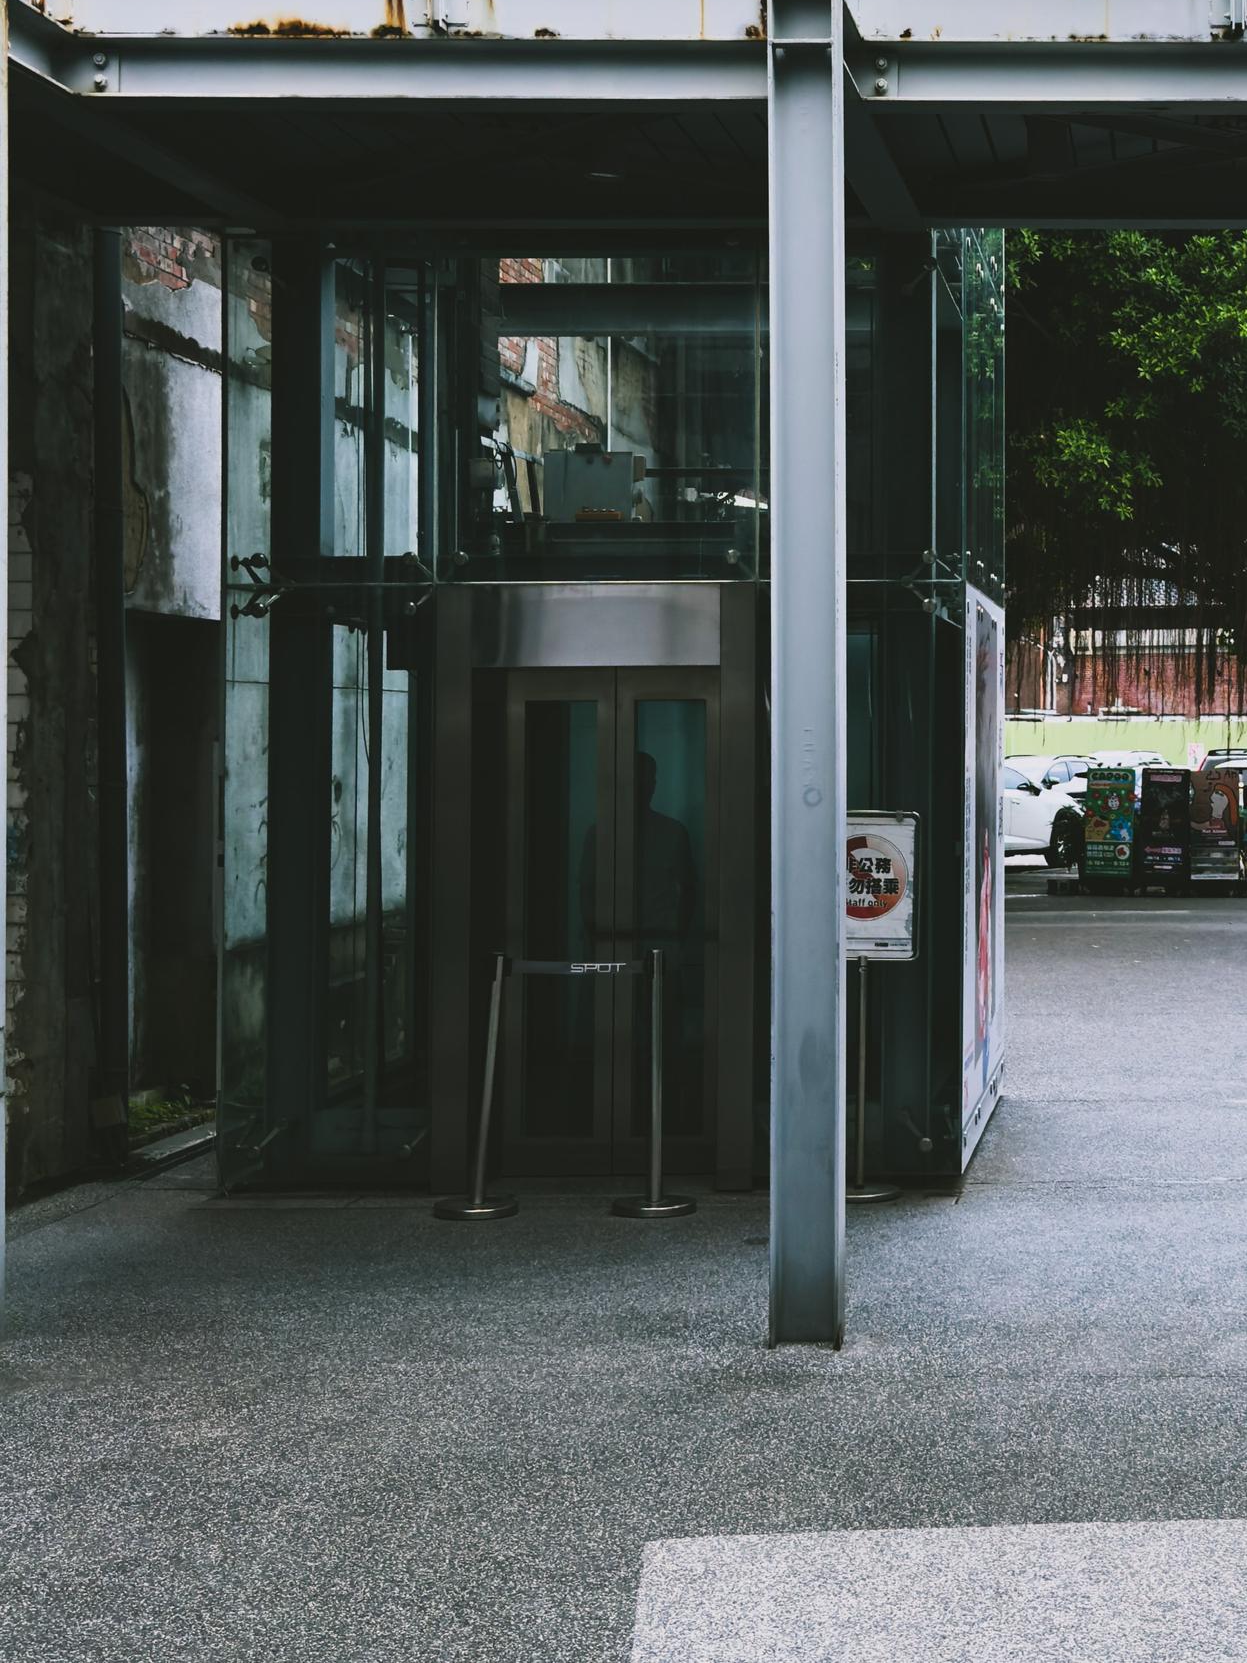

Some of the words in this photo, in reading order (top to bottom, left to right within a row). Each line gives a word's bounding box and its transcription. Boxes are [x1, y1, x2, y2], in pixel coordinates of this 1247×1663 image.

[847, 877, 900, 895] 勿搭乘
[867, 899, 888, 909] only
[570, 962, 627, 973] SPOT
